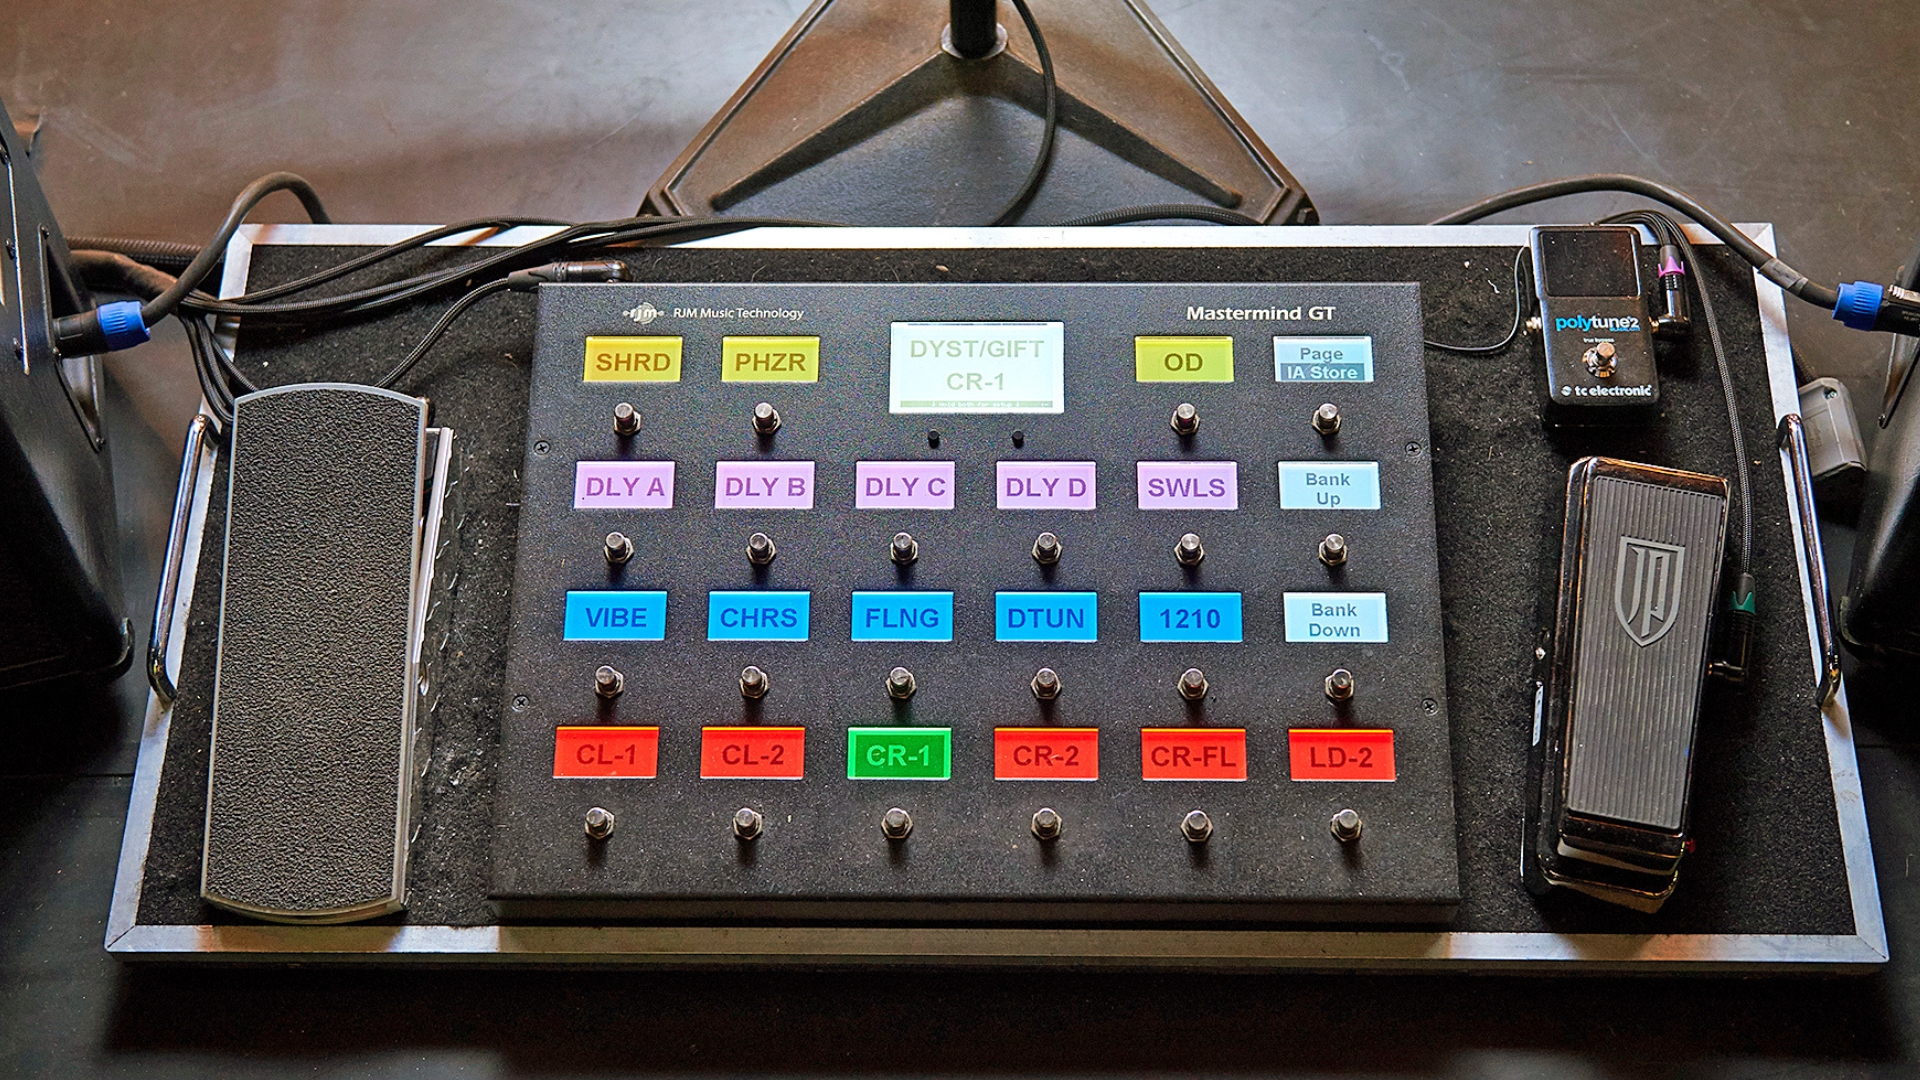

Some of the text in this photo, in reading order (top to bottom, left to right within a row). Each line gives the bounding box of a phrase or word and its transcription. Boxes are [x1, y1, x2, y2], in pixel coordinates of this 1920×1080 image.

[673, 308, 804, 321] RJM Music Technology
[1186, 306, 1336, 321] Mastermind GT
[909, 339, 1045, 358] DYST/GIFT
[1300, 347, 1344, 363] Page
[595, 353, 671, 372] SHRD
[735, 353, 806, 372] PHZR
[1164, 353, 1203, 372] OD
[946, 372, 1004, 391] CR-1
[1287, 366, 1358, 379] IA Store
[1574, 385, 1652, 396] tc electronic
[586, 477, 665, 496] DLY A
[725, 477, 806, 496] DLY B
[865, 477, 946, 497] DLY C
[1006, 478, 1087, 497] DLY D
[1148, 478, 1226, 498] SWLS
[1306, 473, 1350, 486] Bank
[1317, 492, 1341, 507] Up
[585, 607, 647, 628] VIBE
[720, 607, 798, 628] CHRS
[865, 608, 939, 628] FLNG
[1008, 608, 1084, 629] DTUN
[1159, 609, 1221, 629] 1210
[1311, 603, 1357, 617] Bank
[1309, 623, 1361, 637] Down
[576, 744, 636, 765] CL-1
[721, 745, 785, 765] CL-2
[866, 745, 930, 766] CR-1
[1012, 745, 1079, 767] CR-2
[1150, 746, 1237, 767] CR-FL
[1310, 747, 1373, 768] LD-2
